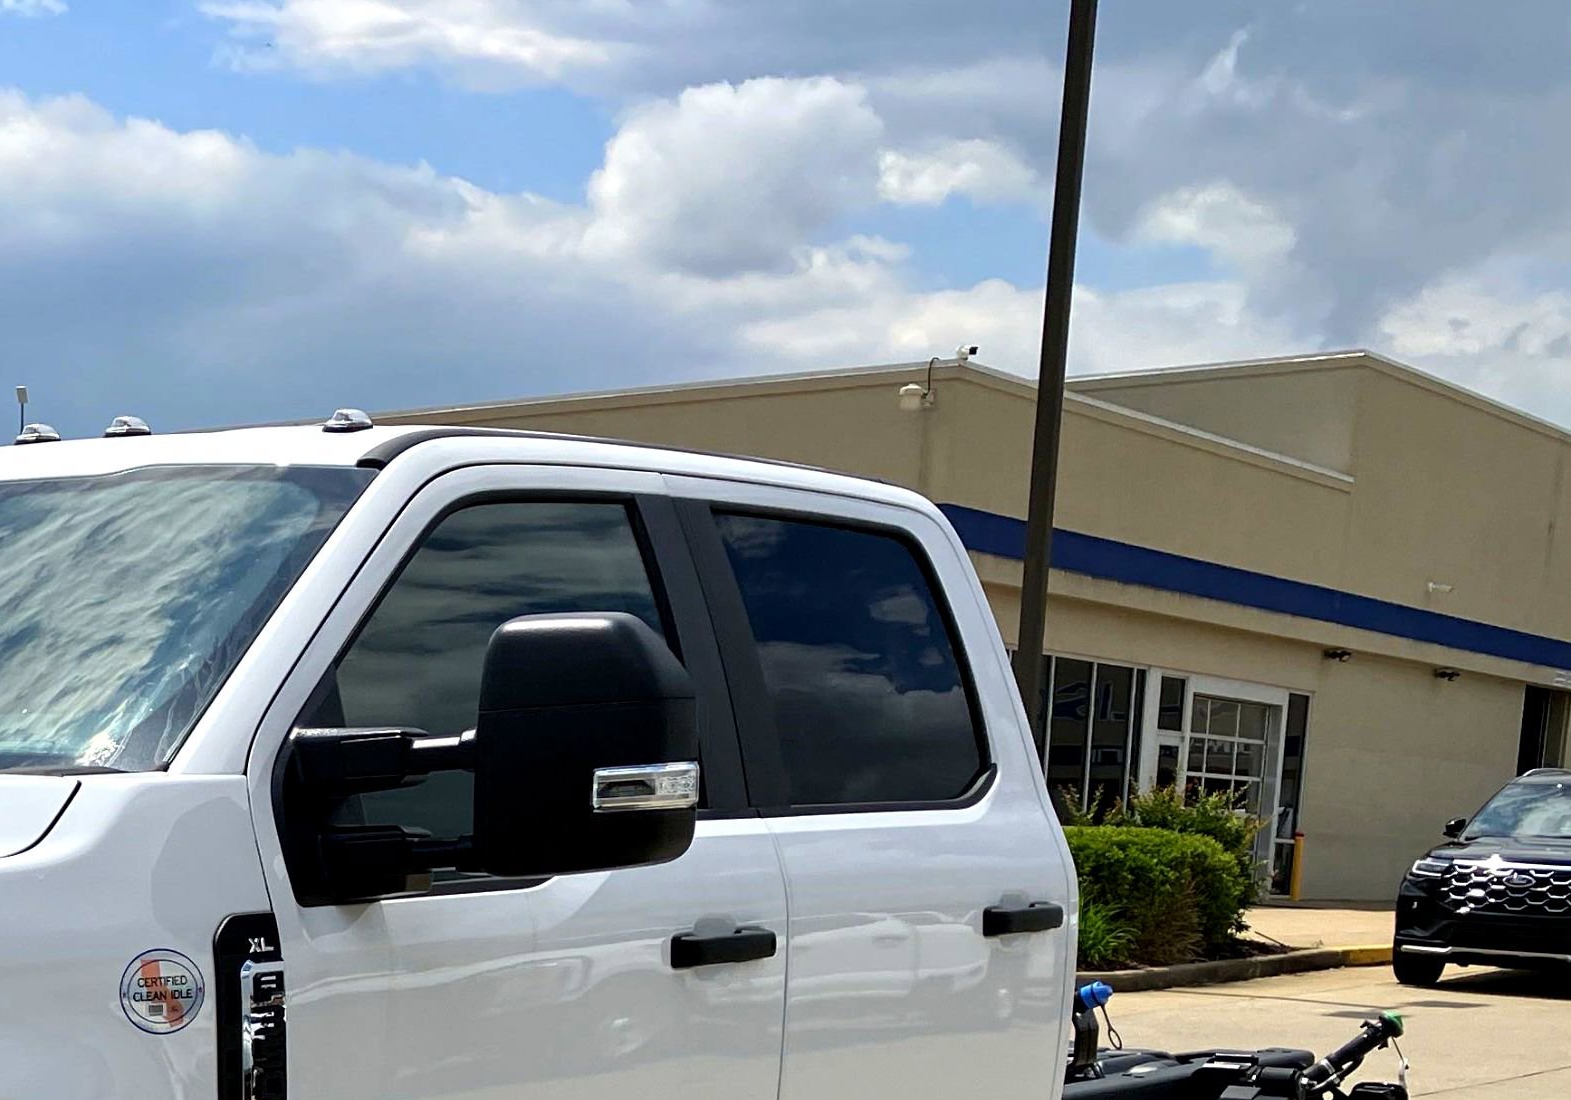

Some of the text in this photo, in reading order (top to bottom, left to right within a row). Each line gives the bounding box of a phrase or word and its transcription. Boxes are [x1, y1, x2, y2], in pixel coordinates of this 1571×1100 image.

[249, 937, 274, 953] XL
[137, 975, 188, 988] CERTIFIED
[133, 989, 193, 1002] CLEAN IDLE
